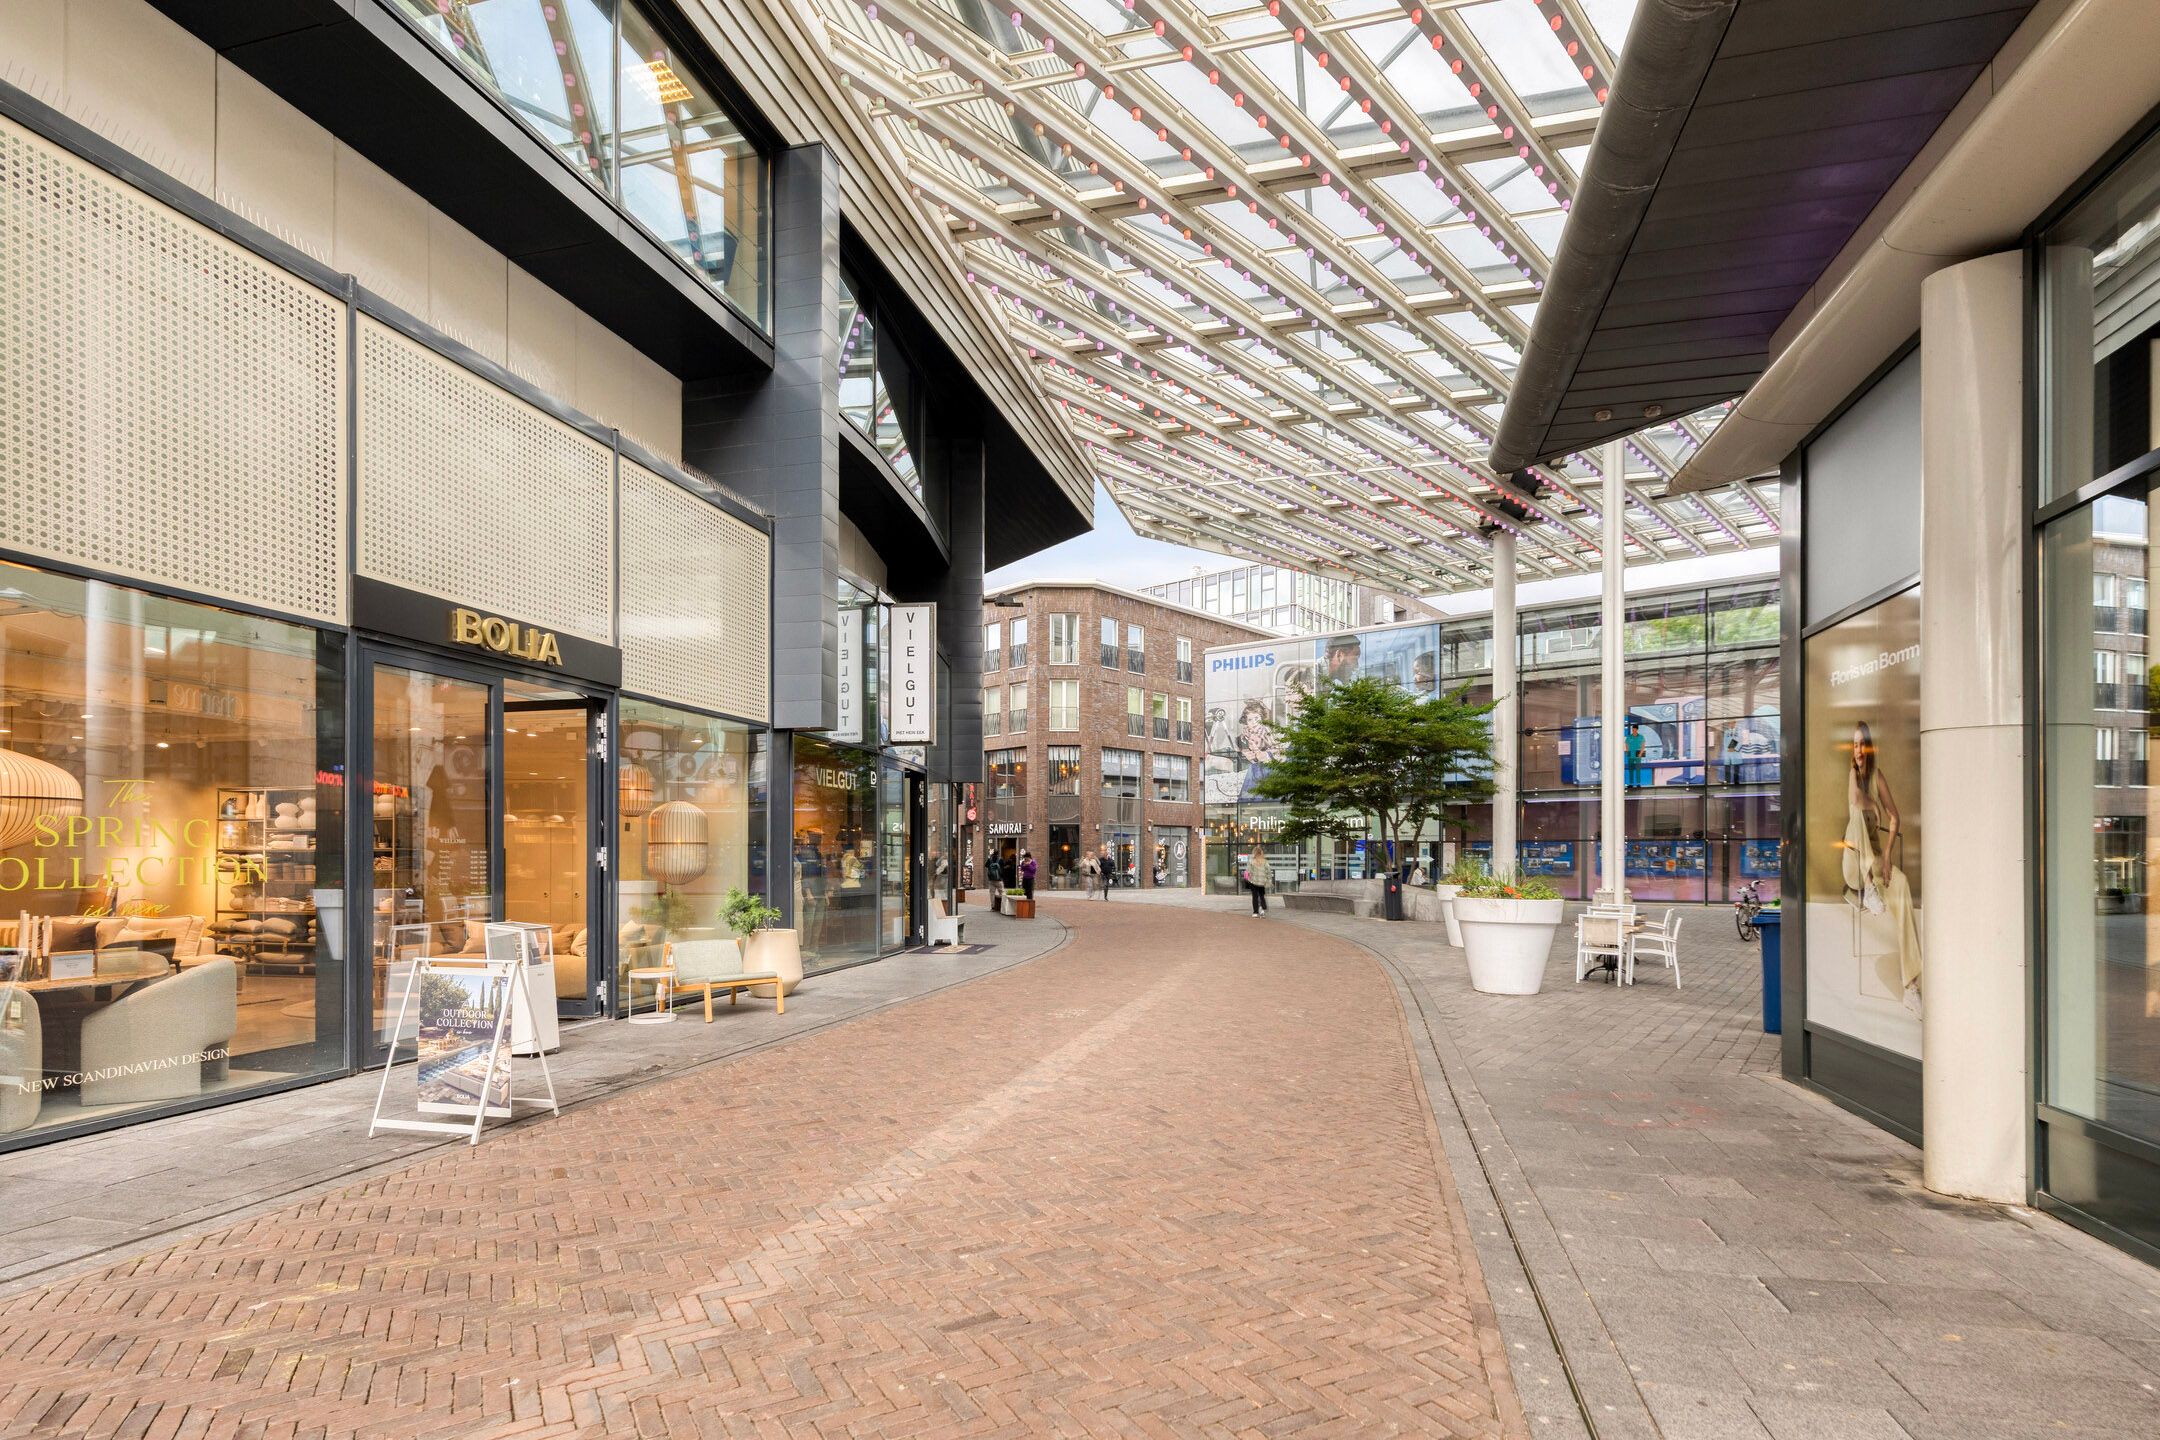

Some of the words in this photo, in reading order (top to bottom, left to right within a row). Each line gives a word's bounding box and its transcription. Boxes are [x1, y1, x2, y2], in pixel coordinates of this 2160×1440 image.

[455, 608, 563, 666] BOLIA
[905, 612, 915, 725] VIELGUT
[1212, 652, 1275, 673] PHILIPS
[816, 767, 857, 790] VIELGUT
[103, 780, 155, 808] The
[34, 814, 210, 848] SPRING
[989, 823, 1022, 834] SAMURAI
[1249, 816, 1288, 833] Philip
[436, 1018, 494, 1029] COLLECTION
[443, 1009, 487, 1019] OUTDOOR
[18, 1077, 59, 1096] NEW
[63, 1056, 178, 1087] SCANDINAVIAN
[182, 1048, 230, 1066] DESIGN
